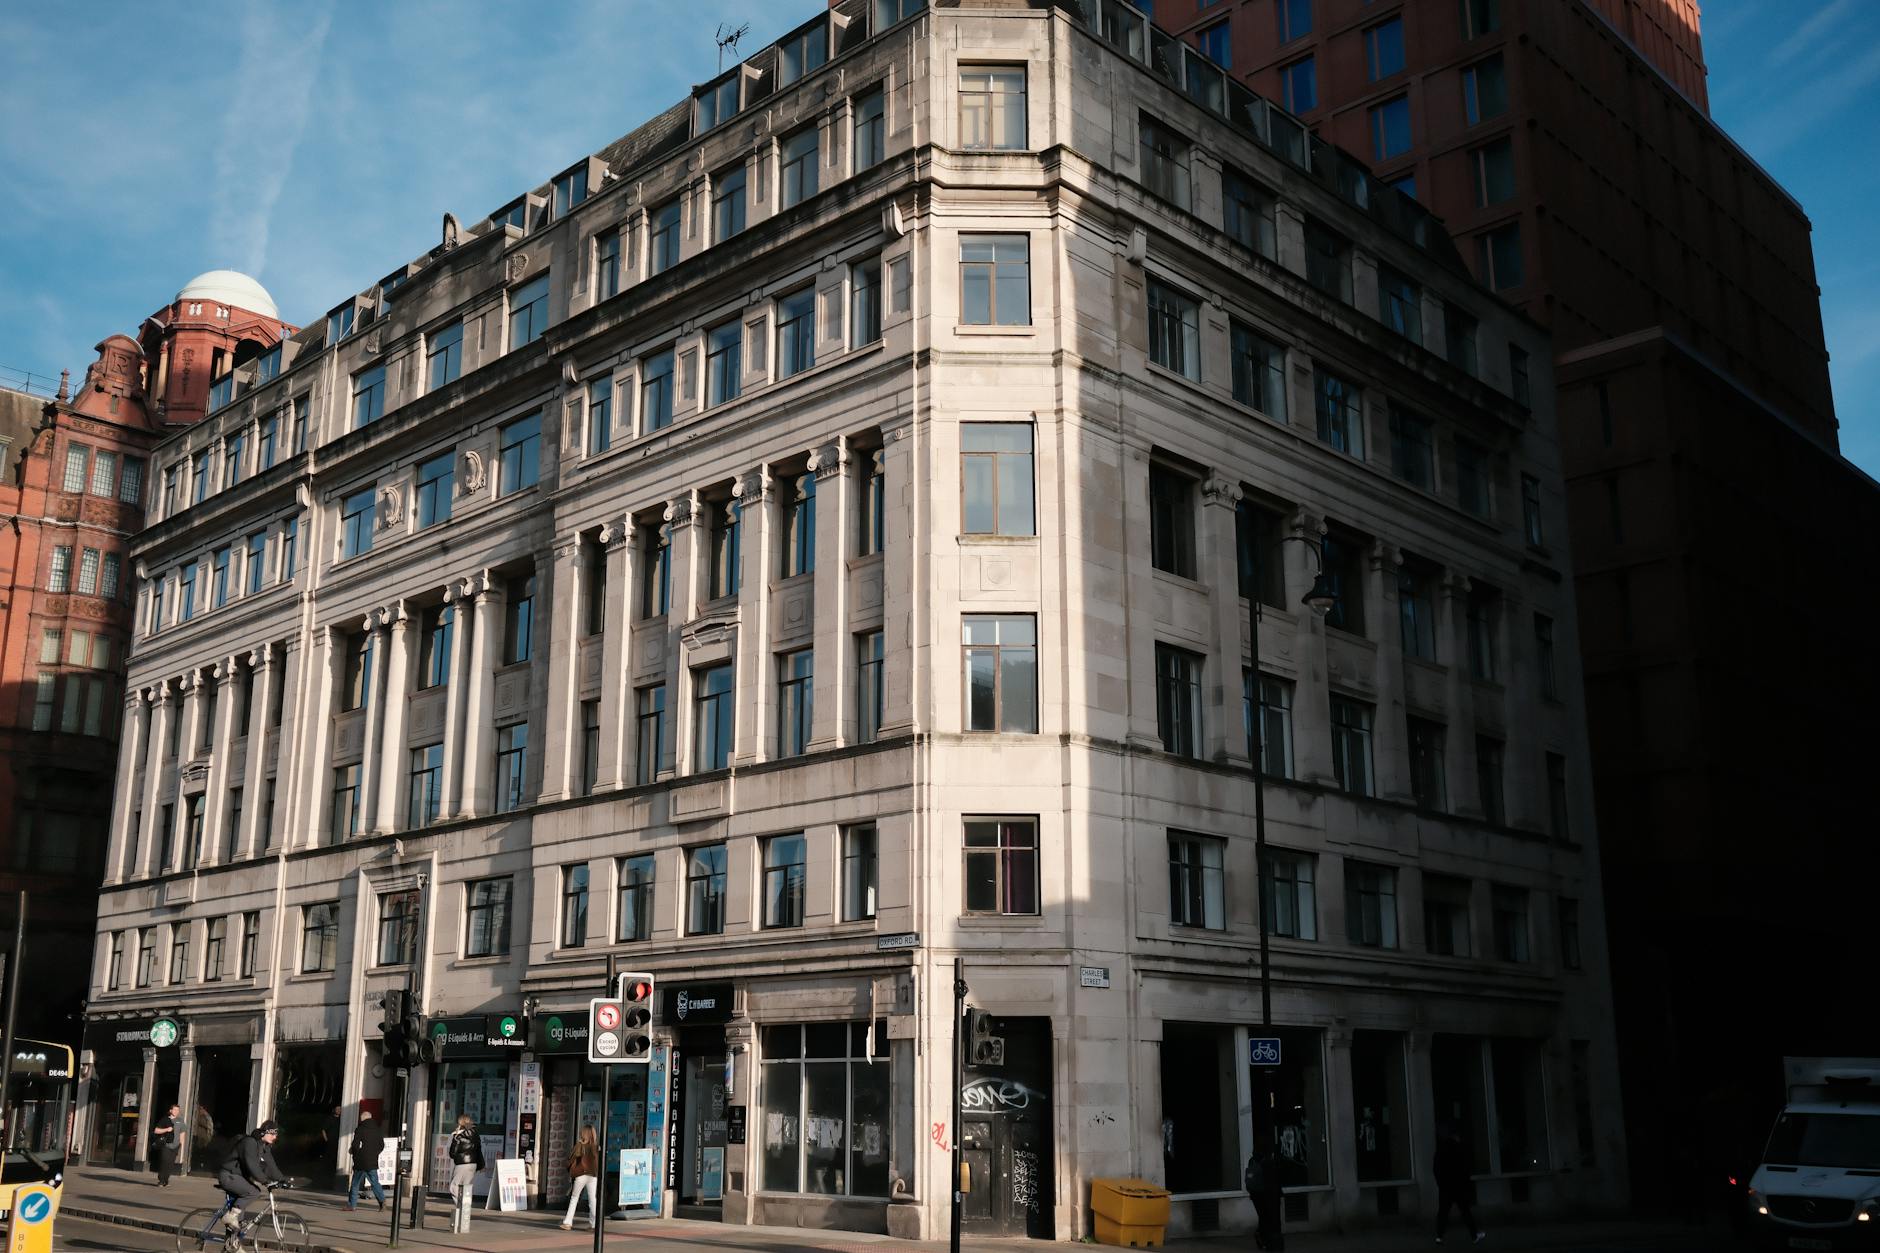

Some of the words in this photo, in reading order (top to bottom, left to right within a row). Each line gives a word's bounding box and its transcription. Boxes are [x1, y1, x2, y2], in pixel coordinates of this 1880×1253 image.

[880, 937, 902, 946] OXFORD
[1082, 969, 1103, 977] CHARLES
[116, 1031, 150, 1042] STARBUCKS
[565, 1026, 588, 1040] E-Liquids
[668, 1109, 678, 1187] BARBER
